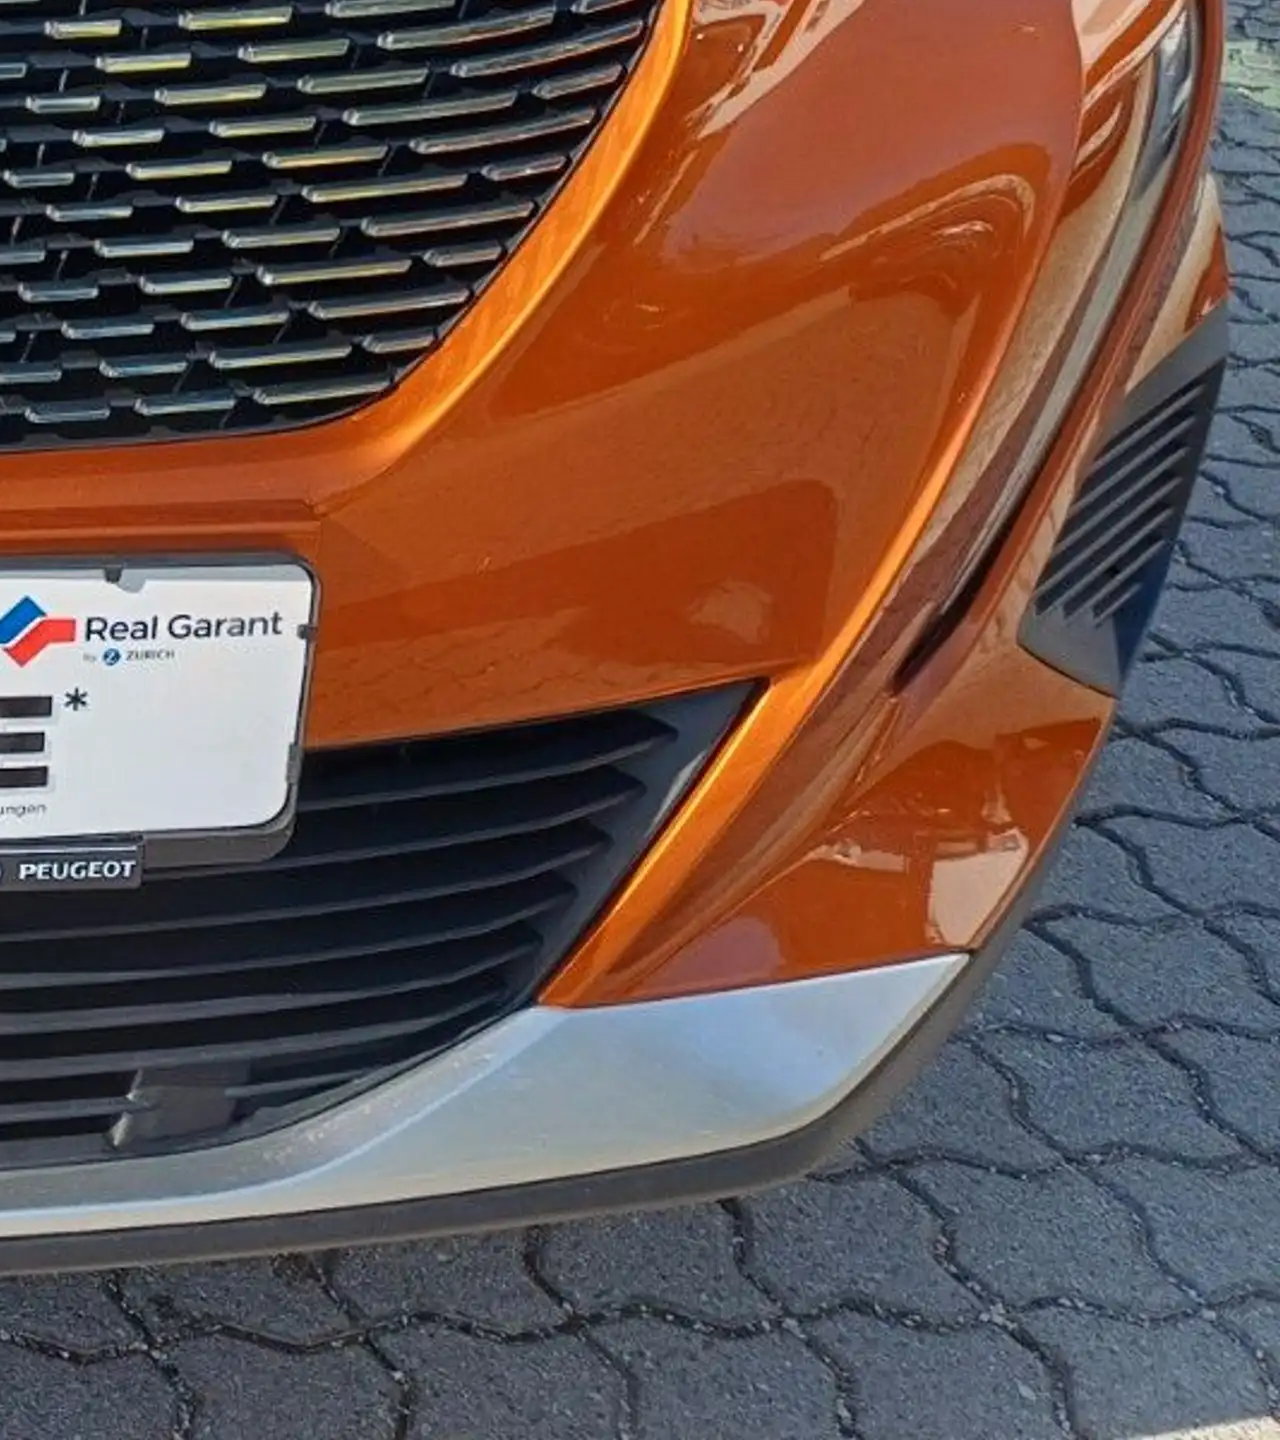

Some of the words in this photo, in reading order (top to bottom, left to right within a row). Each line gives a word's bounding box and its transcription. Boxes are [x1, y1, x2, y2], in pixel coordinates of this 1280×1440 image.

[84, 615, 158, 642] Real
[167, 611, 283, 639] Garant
[126, 649, 175, 662] ZURICH
[18, 860, 137, 882] PEUGEOT
